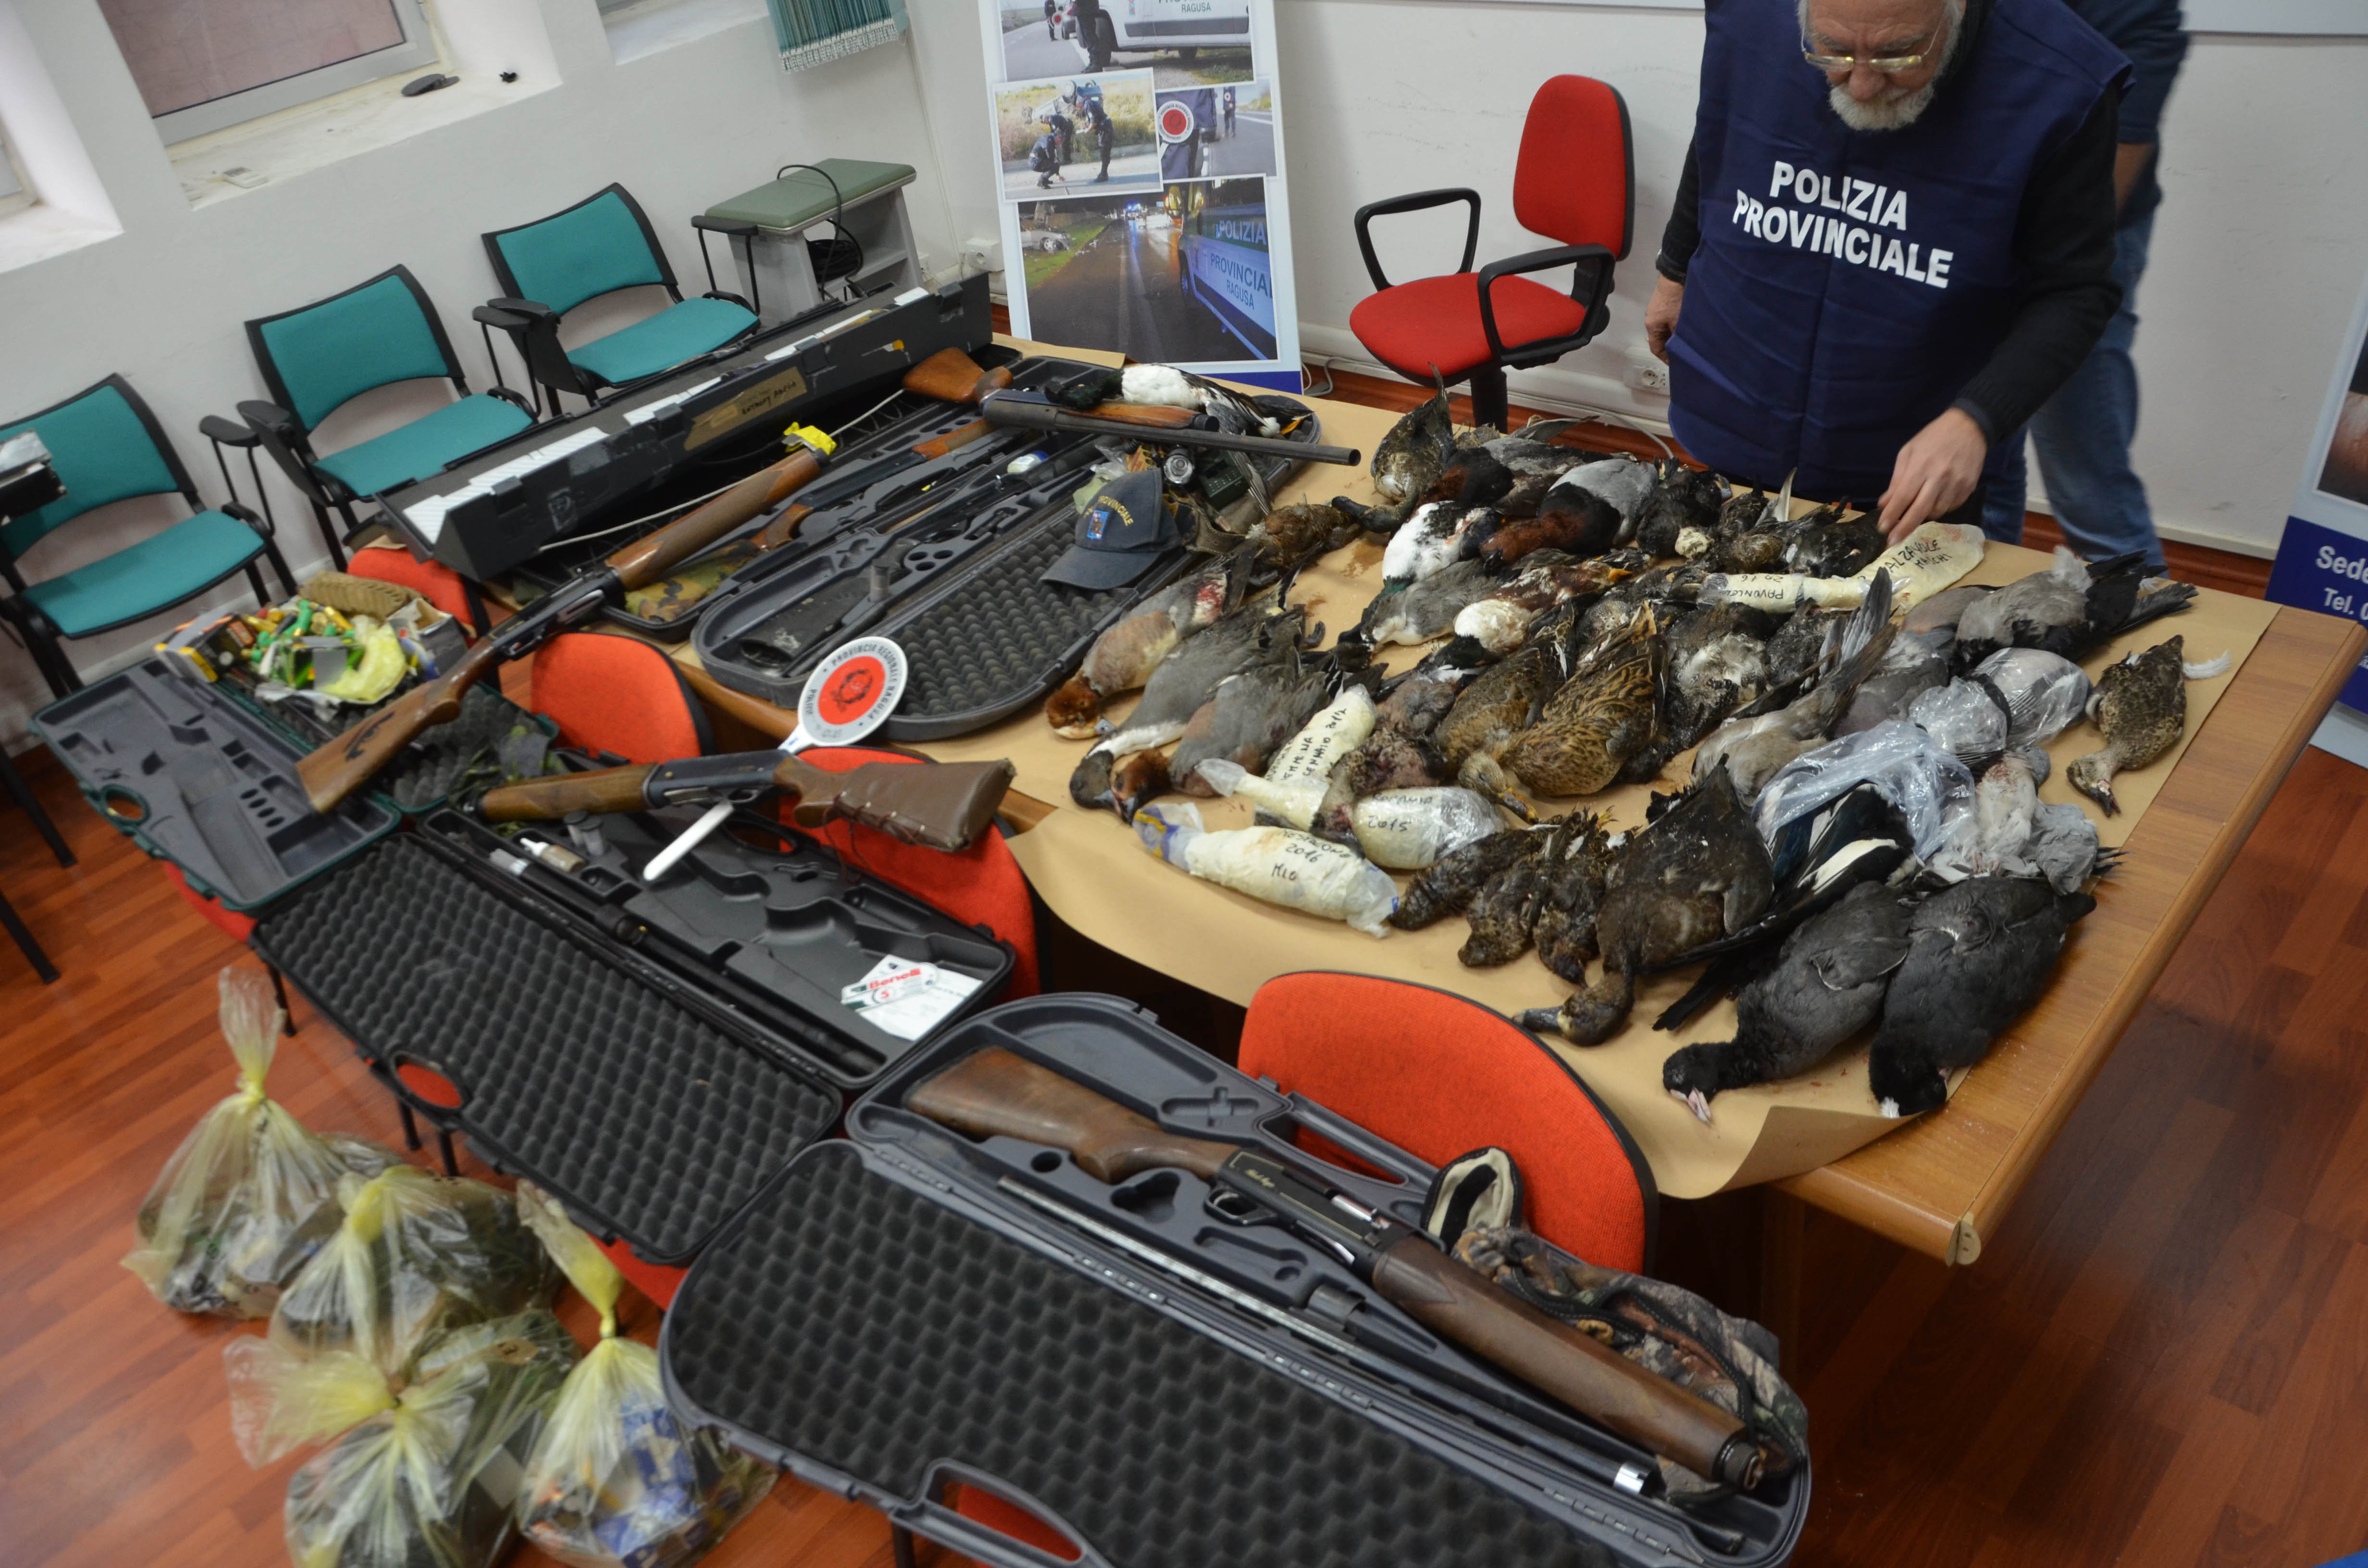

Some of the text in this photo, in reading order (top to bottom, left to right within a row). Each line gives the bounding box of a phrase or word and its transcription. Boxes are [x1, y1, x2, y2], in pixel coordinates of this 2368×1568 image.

[1181, 3, 1211, 13] RAGUSA
[1769, 160, 1907, 231] POLIZIA
[1219, 220, 1267, 245] POLIZIA
[1732, 189, 1954, 289] PROVINCIALE
[1226, 279, 1254, 310] RAGUSA
[2324, 587, 2354, 615] Tel.
[868, 686, 895, 719] RAGUSA
